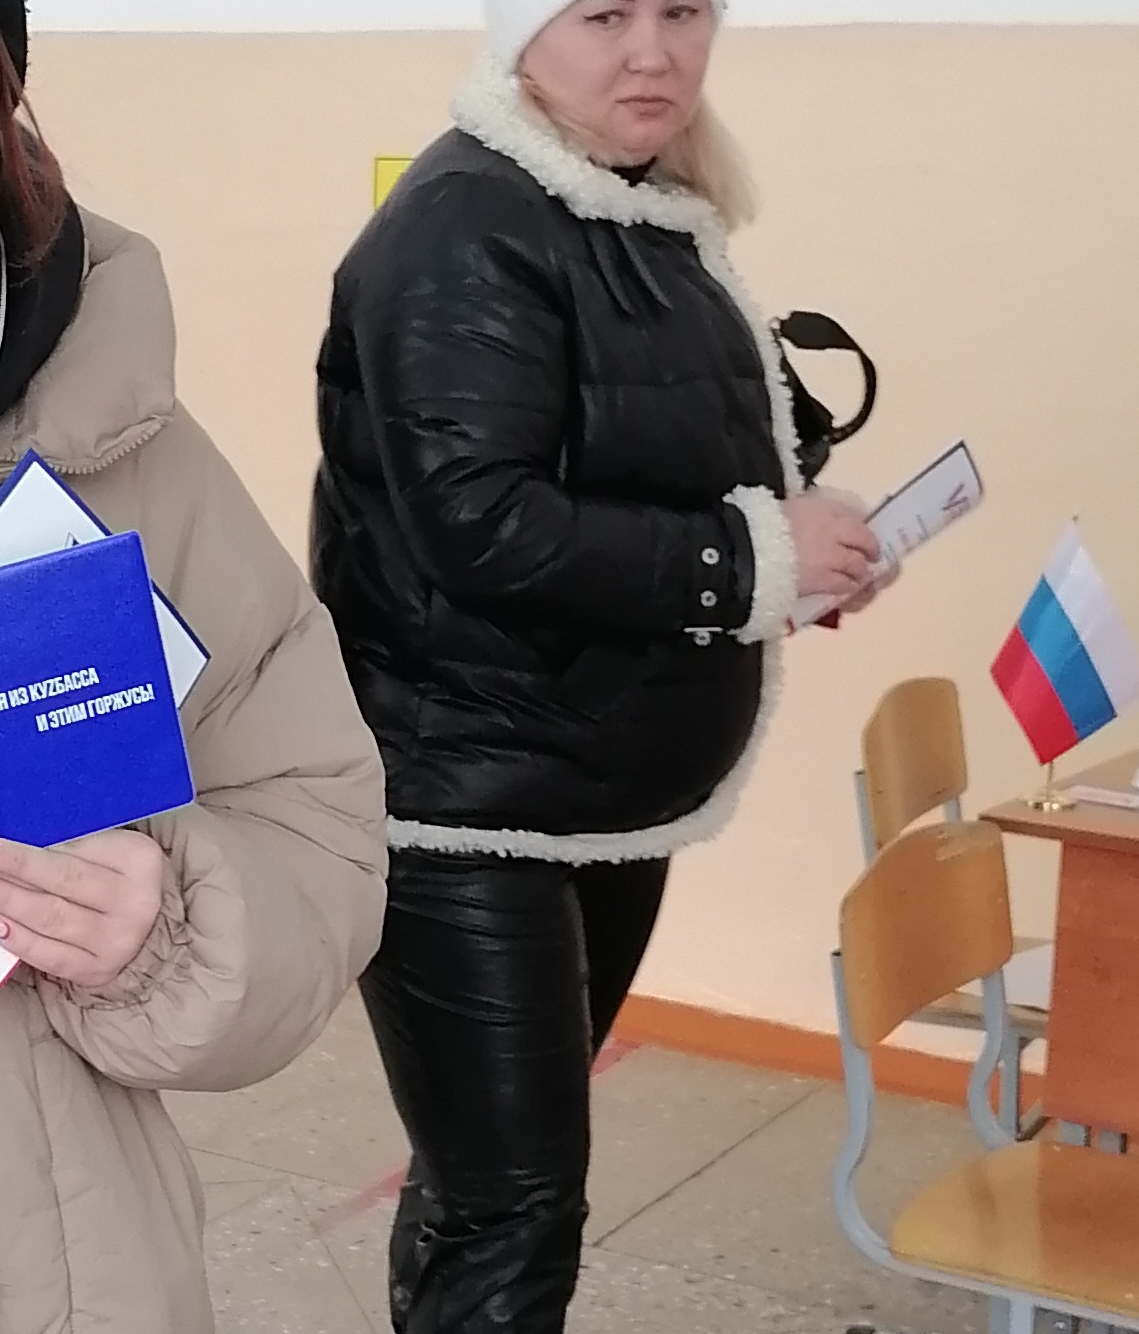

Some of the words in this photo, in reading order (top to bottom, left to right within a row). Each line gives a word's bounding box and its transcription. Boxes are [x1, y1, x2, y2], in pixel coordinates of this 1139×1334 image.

[8, 687, 30, 708] ИЗ
[35, 713, 49, 732] И
[48, 702, 87, 729] ЭТИМ
